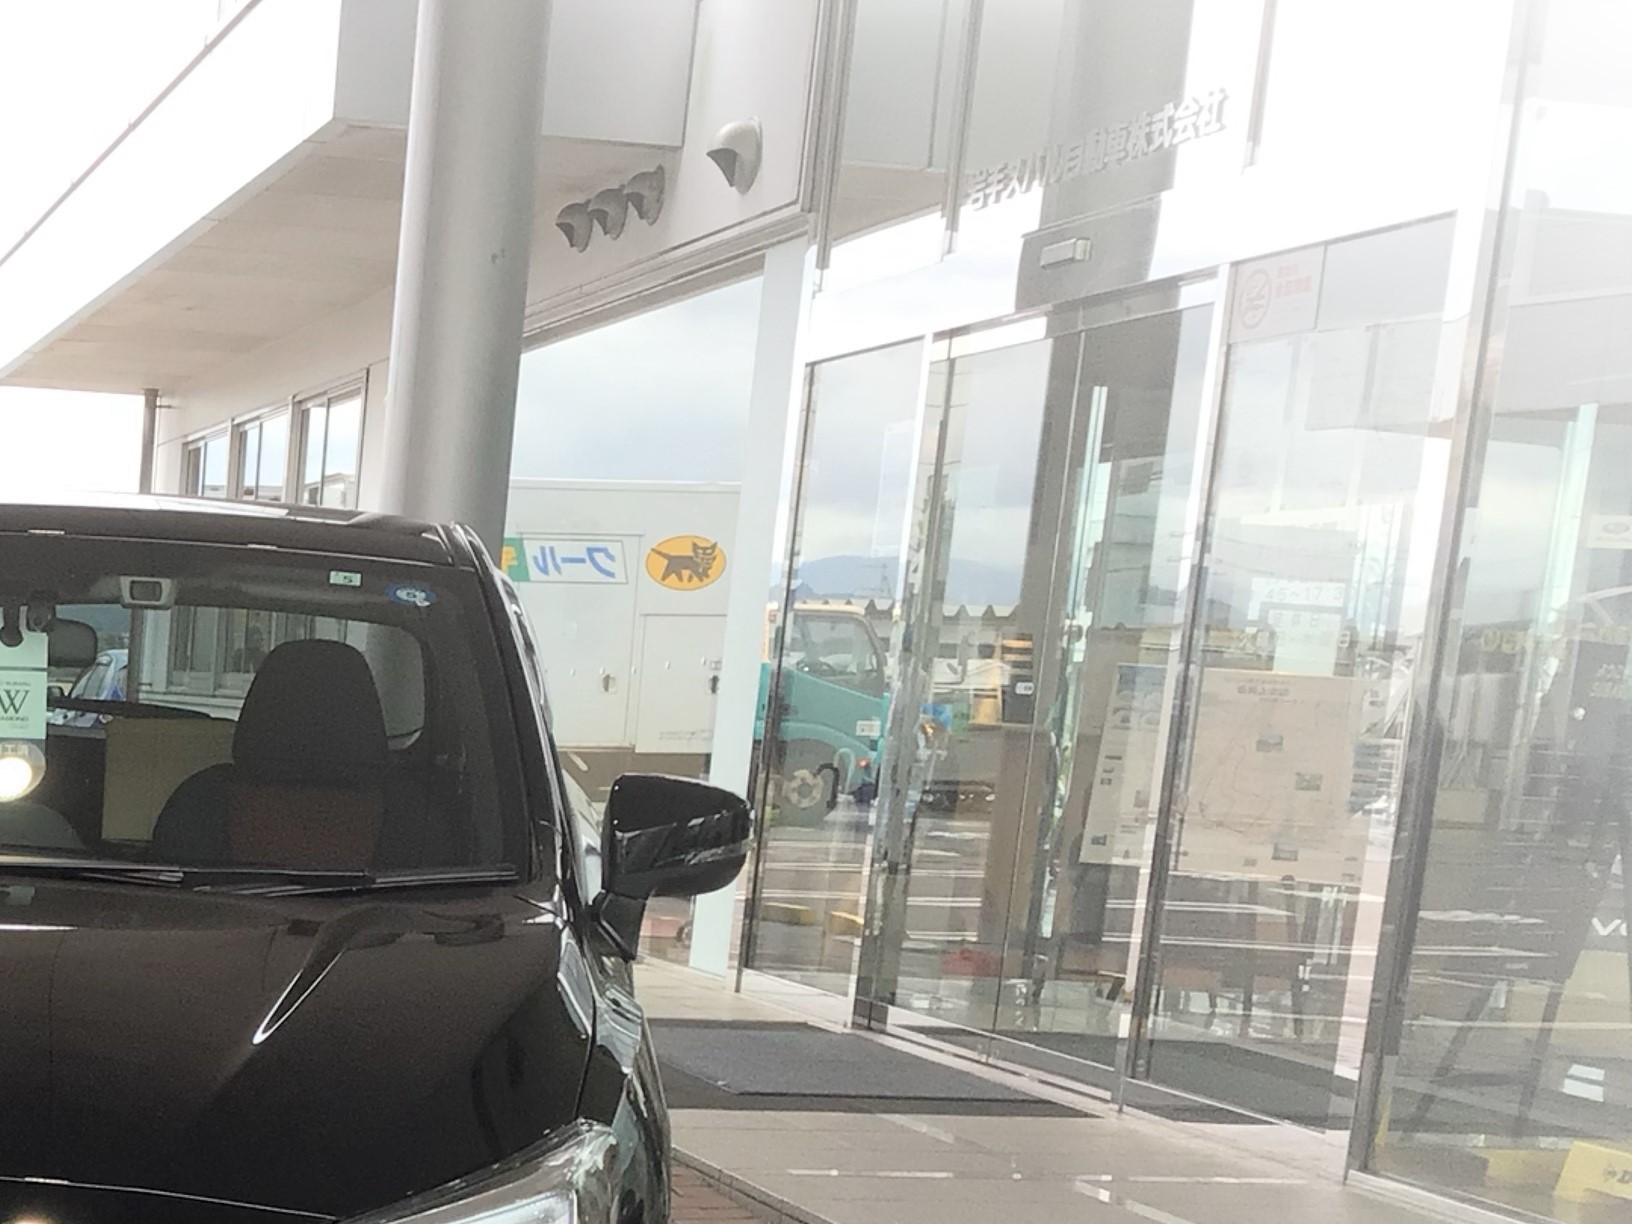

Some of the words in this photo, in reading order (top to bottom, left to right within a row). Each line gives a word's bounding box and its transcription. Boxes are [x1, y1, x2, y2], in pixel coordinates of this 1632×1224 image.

[966, 87, 1229, 212] 岩手スバル自動車株式会社
